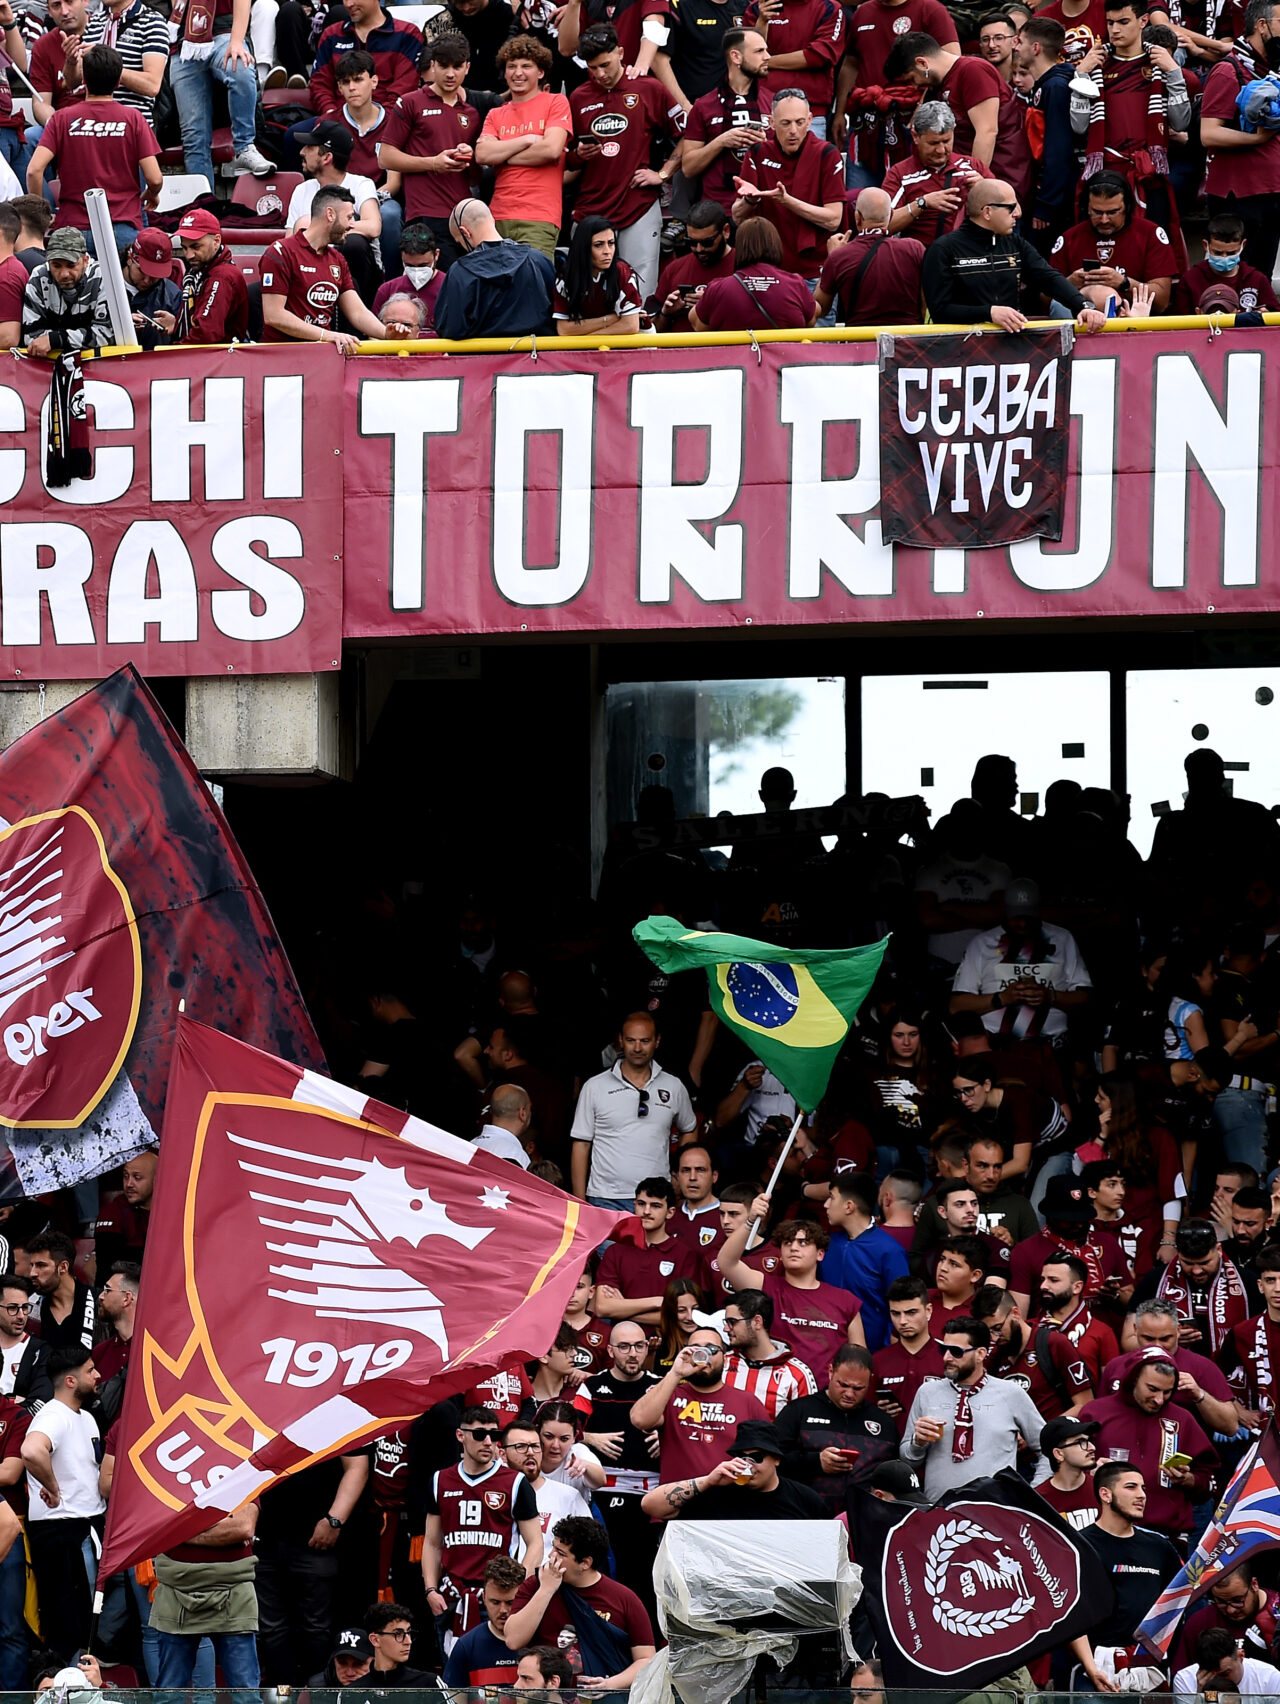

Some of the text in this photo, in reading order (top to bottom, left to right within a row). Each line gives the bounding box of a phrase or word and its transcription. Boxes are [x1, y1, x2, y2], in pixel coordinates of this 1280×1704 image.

[80, 119, 127, 132] Zeus
[594, 119, 626, 131] motta
[959, 257, 987, 266] GIVOVA
[311, 290, 337, 301] motta
[897, 358, 1058, 437] CERBA
[919, 437, 1032, 515] VIVE
[1013, 965, 1041, 976] BCC
[260, 1338, 415, 1389] 1919
[443, 1490, 464, 1498] Zeus
[458, 1500, 482, 1526] 19
[1129, 1565, 1160, 1575] Motorsport
[340, 1631, 361, 1648] NY
